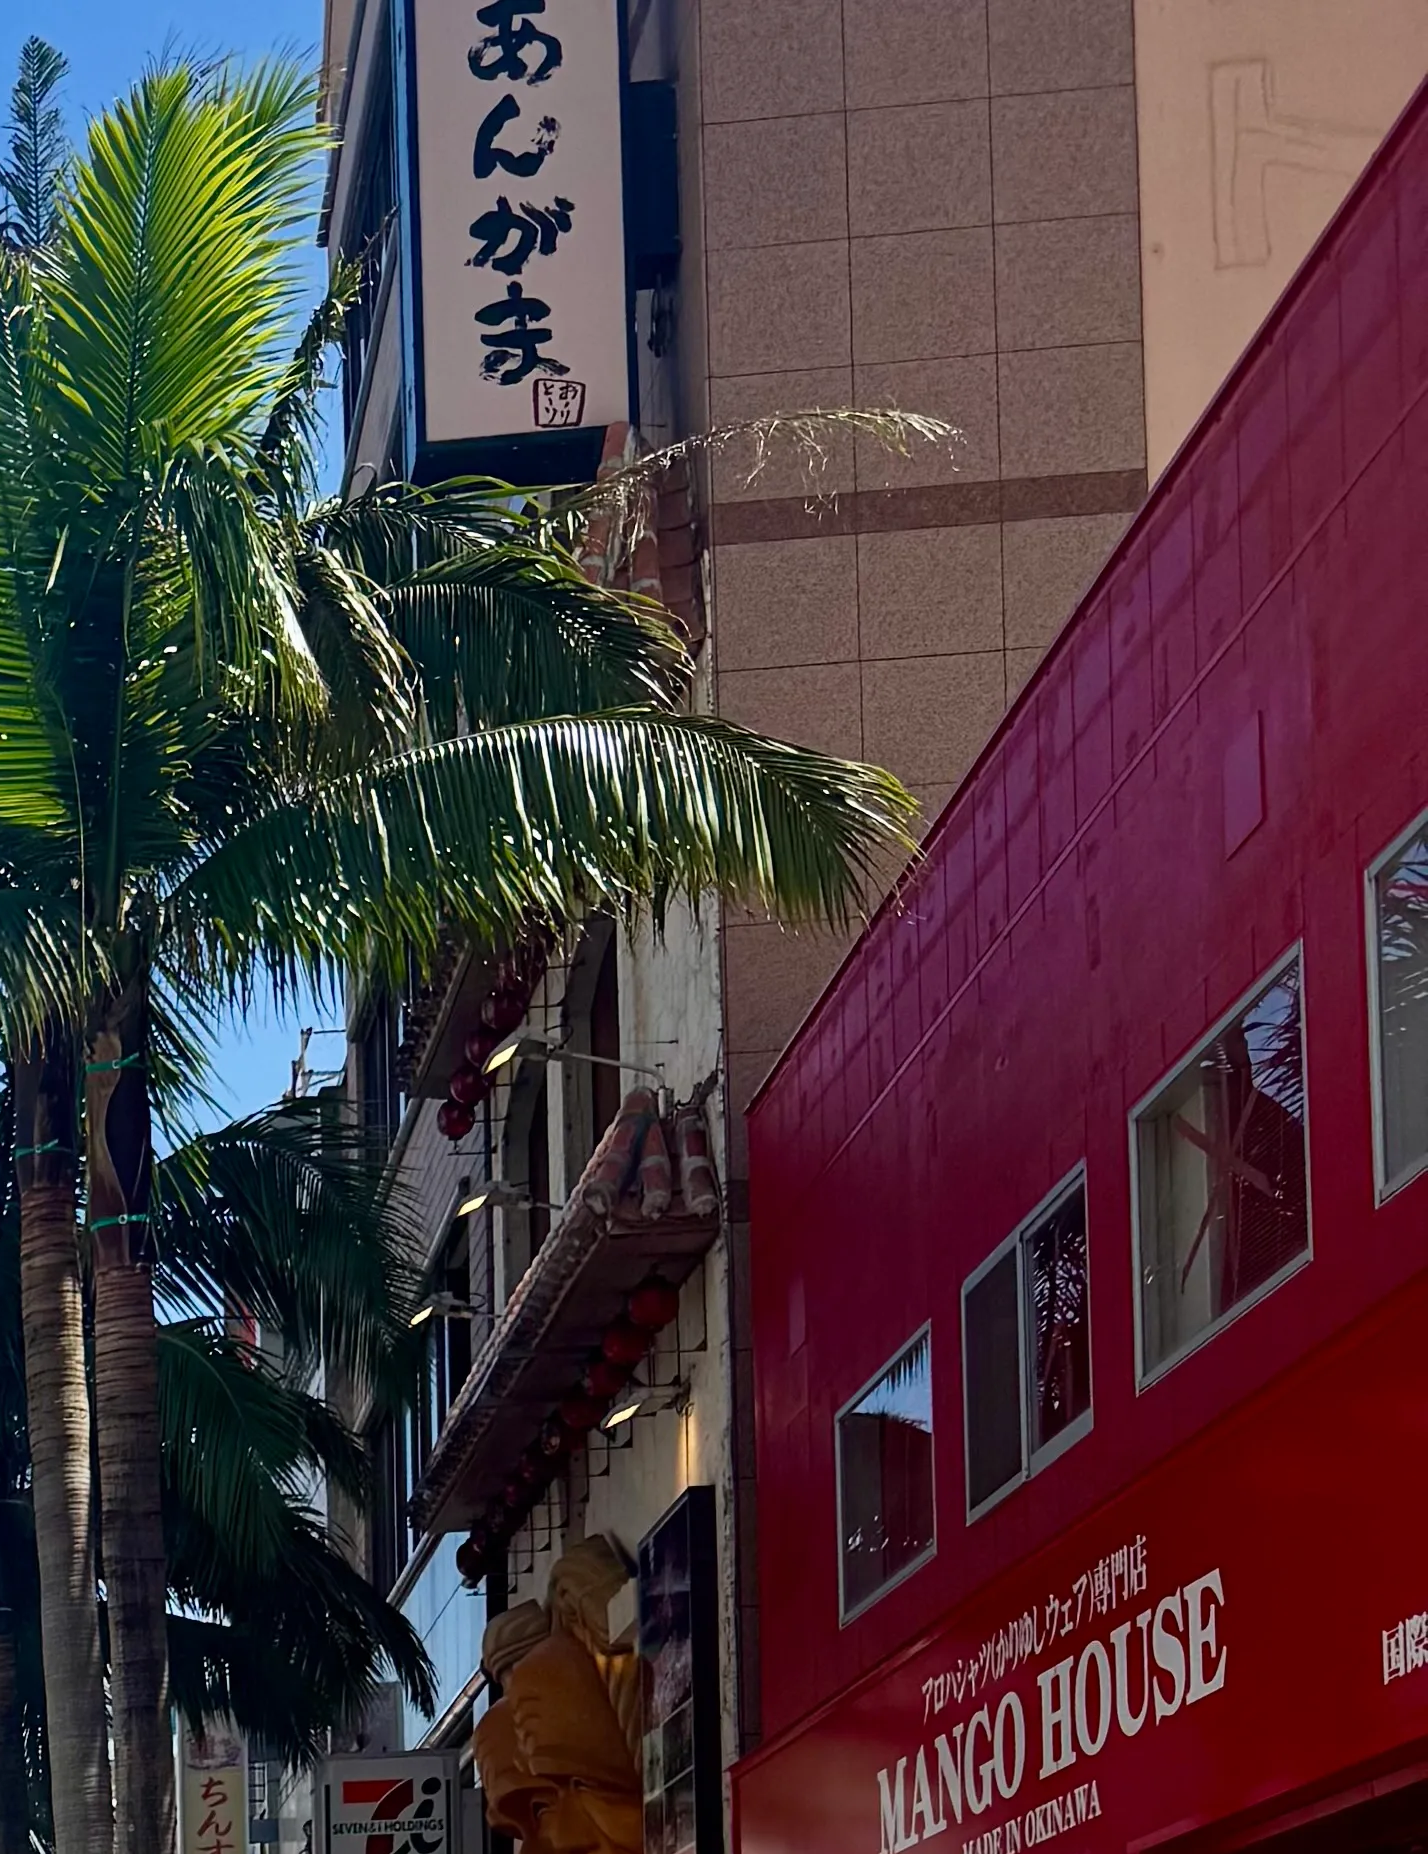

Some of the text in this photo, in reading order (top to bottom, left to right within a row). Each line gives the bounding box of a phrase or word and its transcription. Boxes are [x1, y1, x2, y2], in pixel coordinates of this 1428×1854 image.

[464, 0, 575, 385] あんがま
[1037, 1568, 1228, 1780] HOUSE
[1024, 1780, 1102, 1849] OKINAWA
